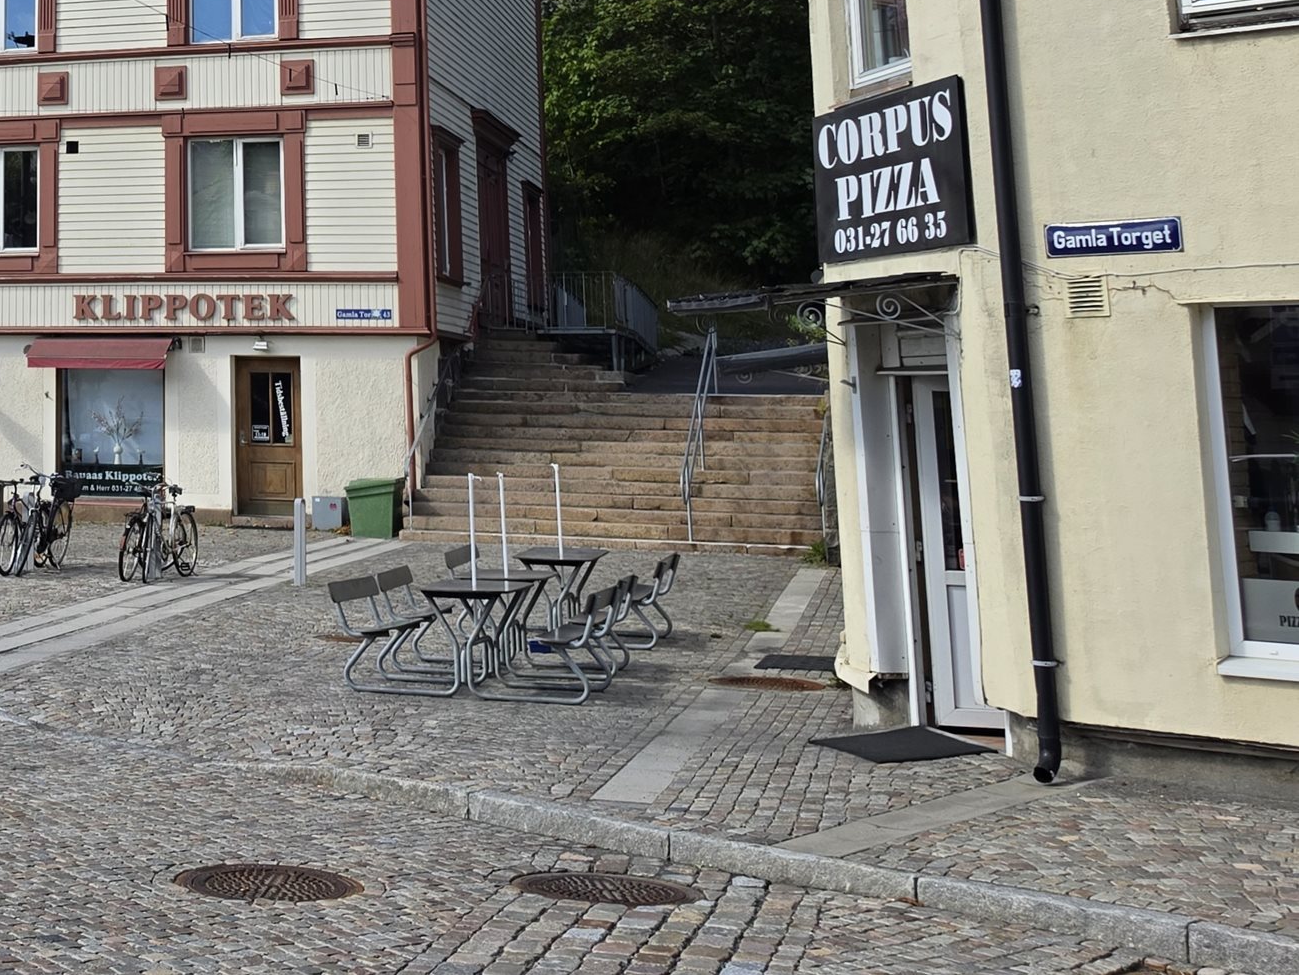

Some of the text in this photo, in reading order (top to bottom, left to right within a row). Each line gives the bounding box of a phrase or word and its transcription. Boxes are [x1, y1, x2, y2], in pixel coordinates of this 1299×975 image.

[818, 88, 953, 170] CORPUS
[834, 157, 941, 221] PIZZA
[834, 210, 948, 254] 031-27 66 35
[1052, 224, 1172, 249] Gamla Torget
[72, 293, 296, 322] KLIPPOTEK
[336, 310, 358, 318] Gamla
[104, 470, 160, 483] Klippote
